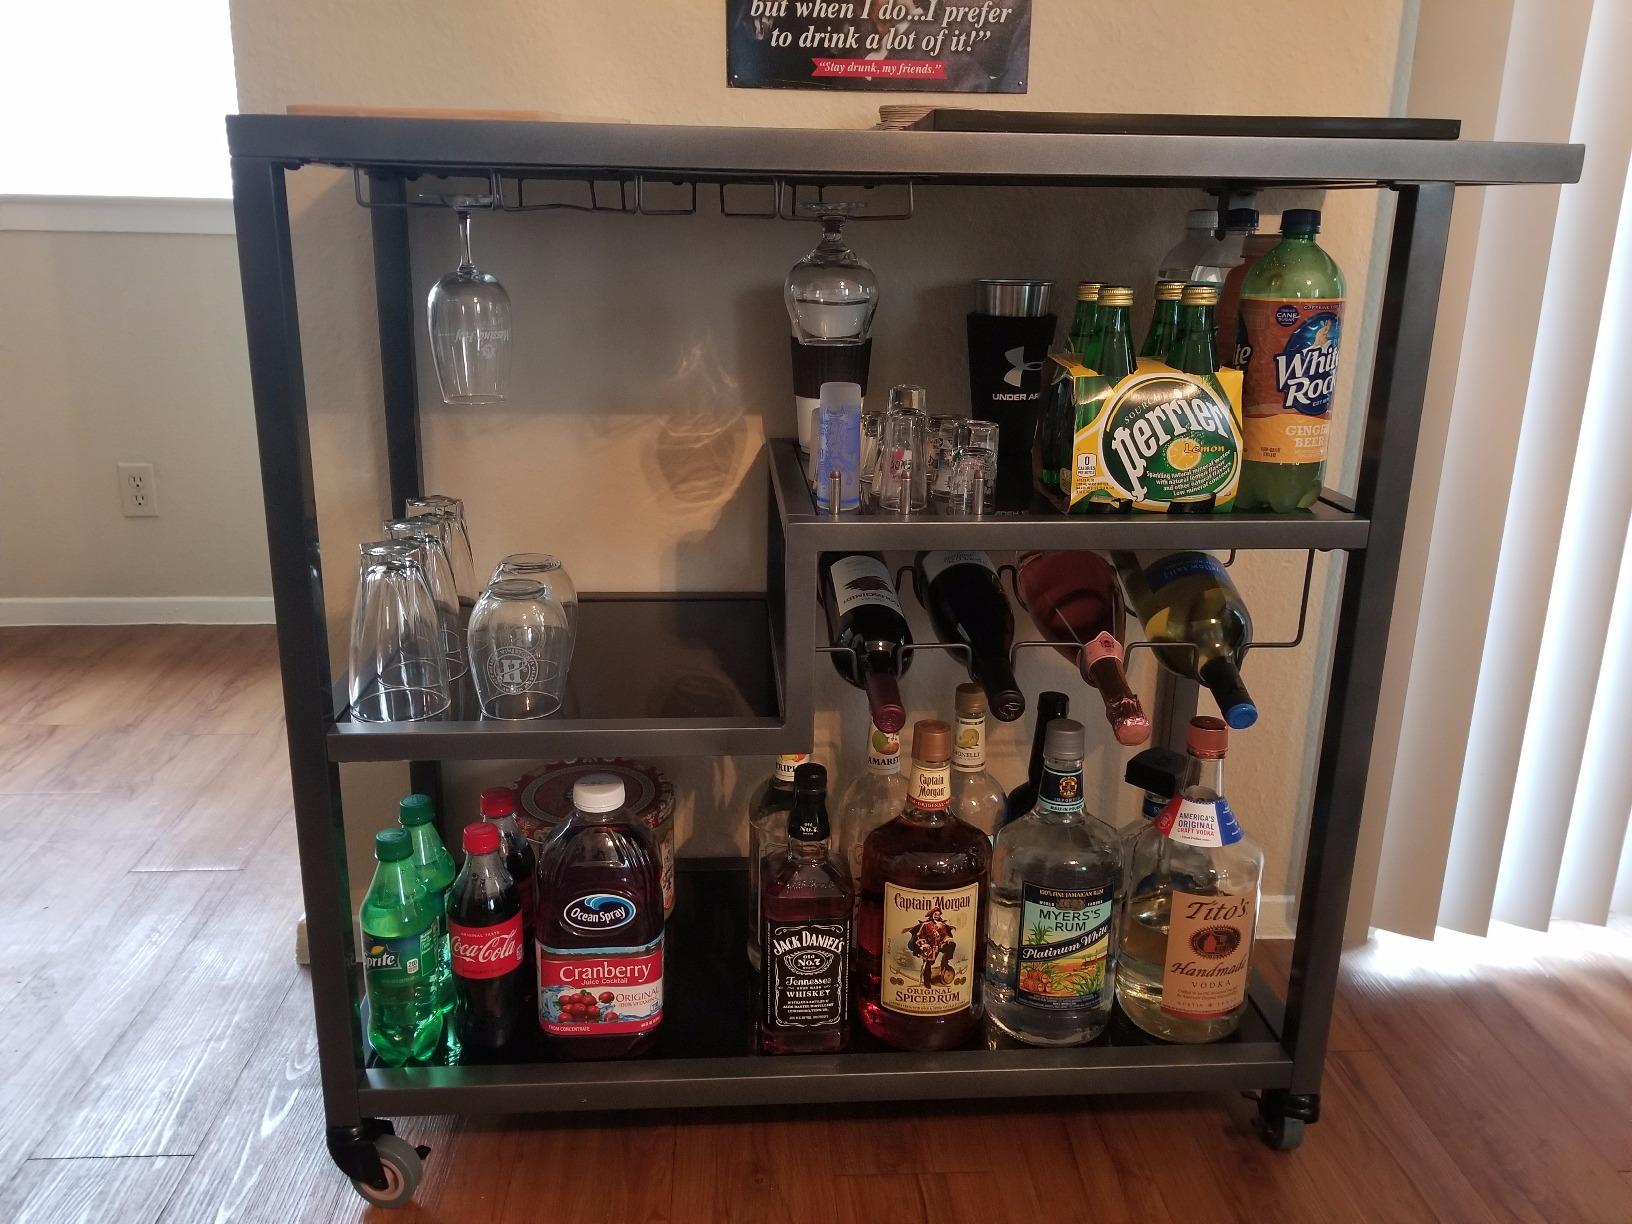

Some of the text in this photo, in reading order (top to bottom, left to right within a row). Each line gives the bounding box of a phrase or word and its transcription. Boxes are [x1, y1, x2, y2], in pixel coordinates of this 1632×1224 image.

[751, 0, 788, 18] but
[796, 0, 854, 20] when
[859, 0, 872, 20] I
[940, 2, 1012, 29] prefer
[770, 27, 793, 48] to
[798, 26, 859, 50] drink
[865, 34, 884, 50] a
[886, 28, 917, 51] lot
[921, 30, 947, 57] of
[846, 63, 881, 74] drunk,
[882, 65, 897, 77] my
[992, 393, 1027, 401] UNDER
[1183, 442, 1225, 454] Lemon
[1084, 455, 1091, 466] 0
[1145, 470, 1171, 480] Sparkling
[1171, 467, 1192, 479] natural
[1192, 460, 1214, 474] mineral
[1168, 474, 1189, 485] natural
[1189, 470, 1209, 482] lemon
[1190, 474, 1212, 487] natural
[1186, 481, 1209, 494] mineral
[917, 785, 944, 798] Morgan
[1178, 812, 1216, 823] AMERICA'S
[1178, 819, 1215, 831] ORIGINAL
[1195, 828, 1215, 837] VODKA
[894, 892, 971, 912] Captain Morgan
[569, 906, 627, 924] Ocean Spray
[1039, 907, 1102, 922] MYERS'S
[1185, 897, 1250, 921] Tito's
[1054, 921, 1088, 933] RUM
[451, 928, 518, 963] Coca-Cola
[773, 930, 846, 956] JACK DANIEL'S
[1022, 943, 1082, 960] Platinum
[559, 961, 652, 983] Cranberry
[580, 977, 629, 986] Juice Cocktail
[785, 976, 832, 986] Tennessee
[1191, 979, 1232, 990] VODKA
[615, 986, 660, 1003] ORIGINAL
[786, 988, 831, 998] WHISKEY
[895, 990, 961, 1005] SPICED RUM
[906, 987, 952, 996] ORIGINAL
